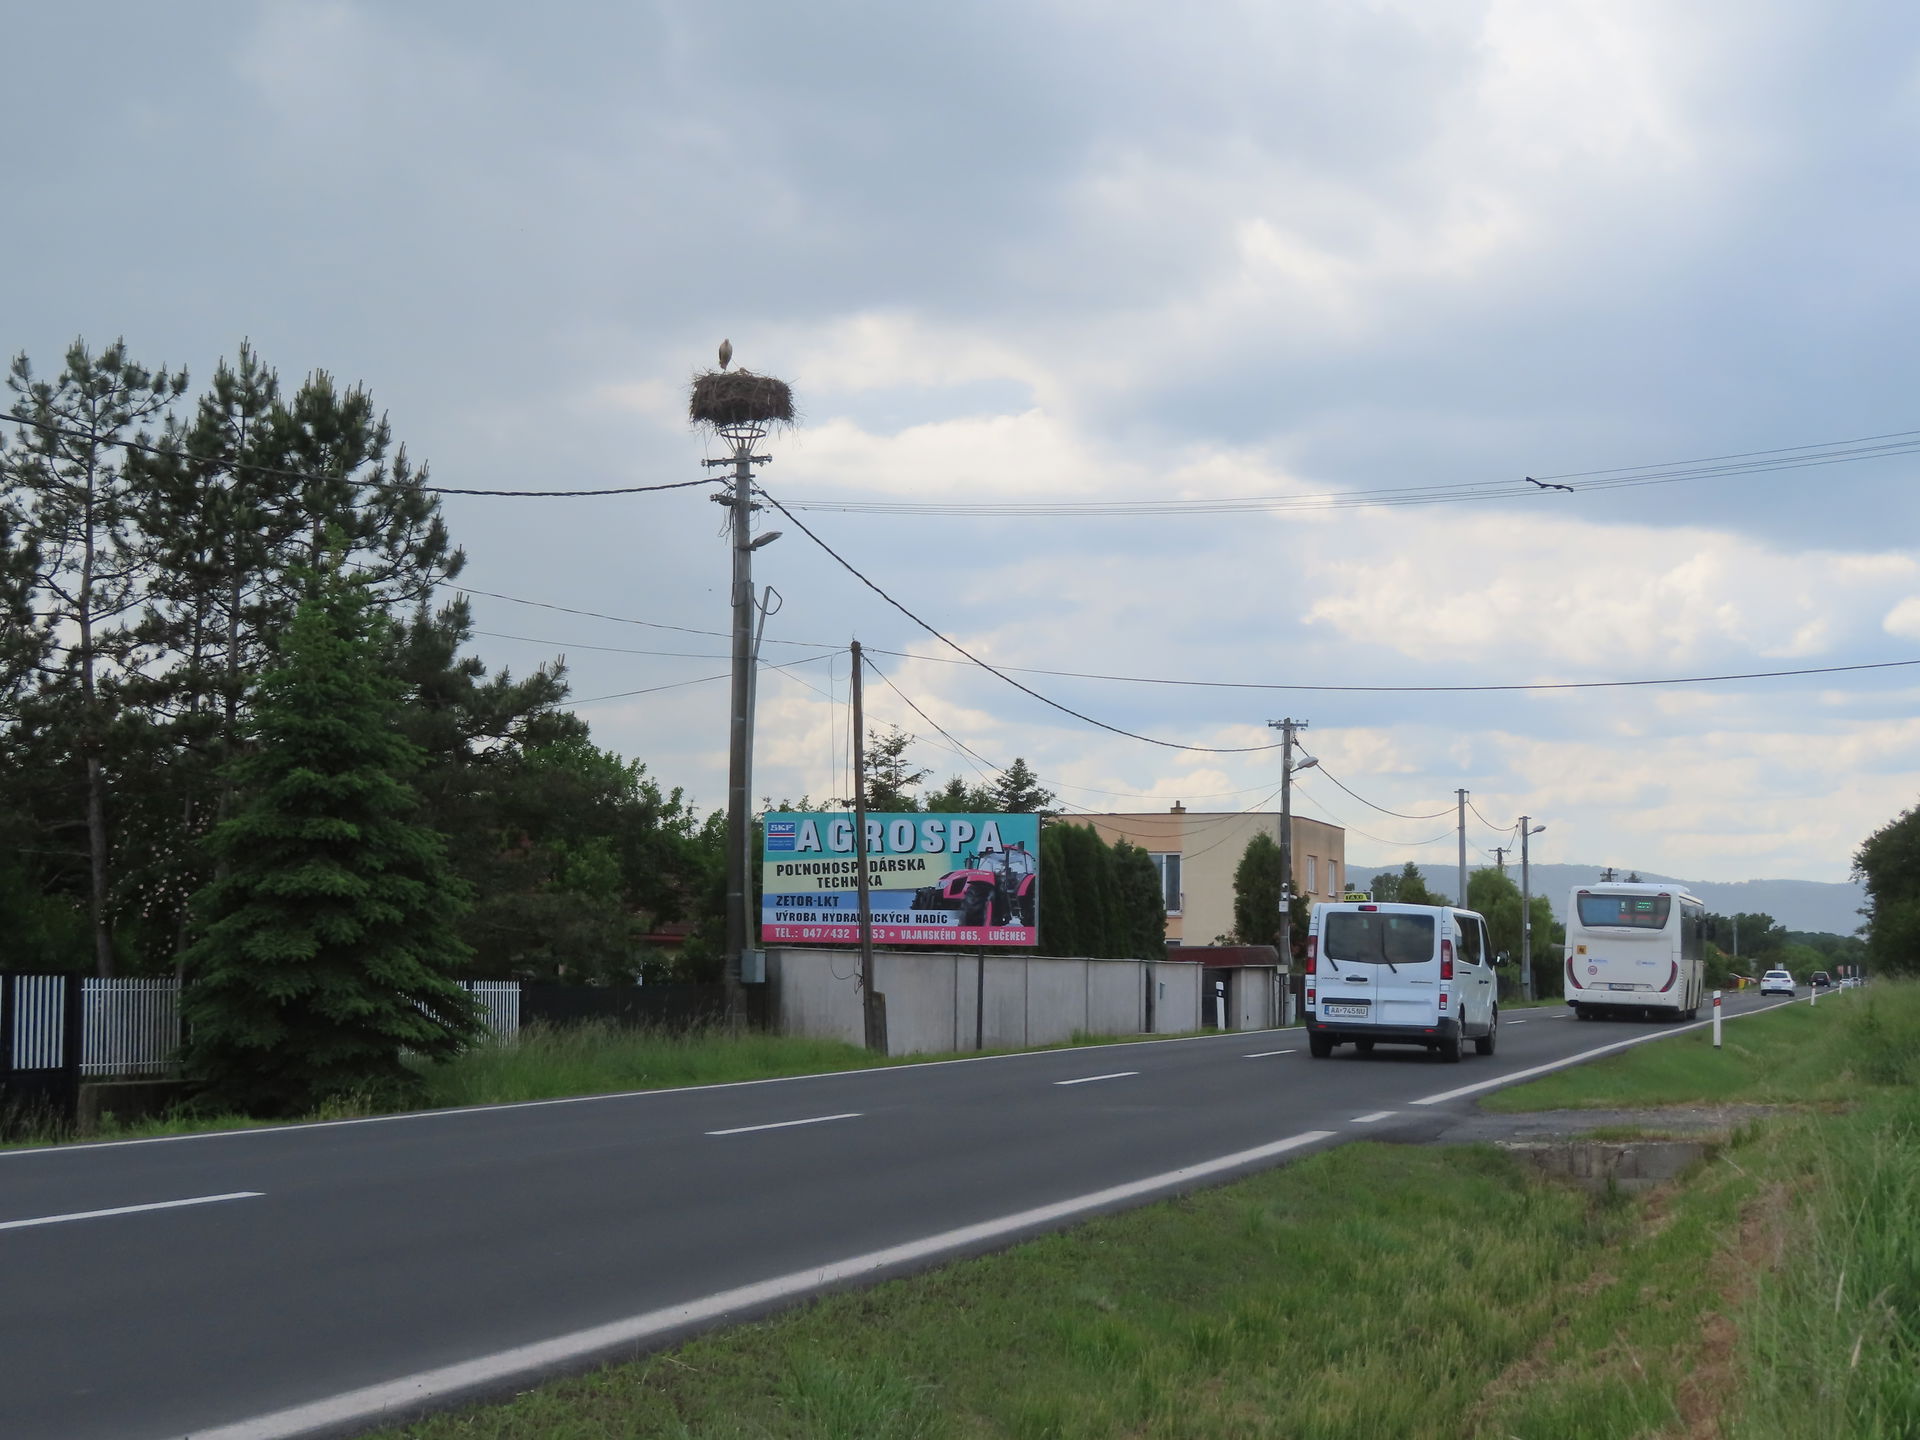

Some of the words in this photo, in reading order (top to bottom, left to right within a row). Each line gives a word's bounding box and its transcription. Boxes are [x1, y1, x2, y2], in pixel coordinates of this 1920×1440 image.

[797, 819, 1004, 853] AGROSPA
[776, 857, 926, 876] POĽNOHOSPDÁRSKA
[816, 875, 882, 889] TECHNKA
[776, 895, 840, 907] ZETOR-LKT
[775, 910, 817, 922] VÝROBA
[915, 912, 948, 924] HADÍC
[775, 928, 798, 938] TEL.:
[803, 928, 850, 939] 047/432
[900, 928, 956, 940] VAJANSKÉHO
[989, 928, 1026, 941] LUČENEC
